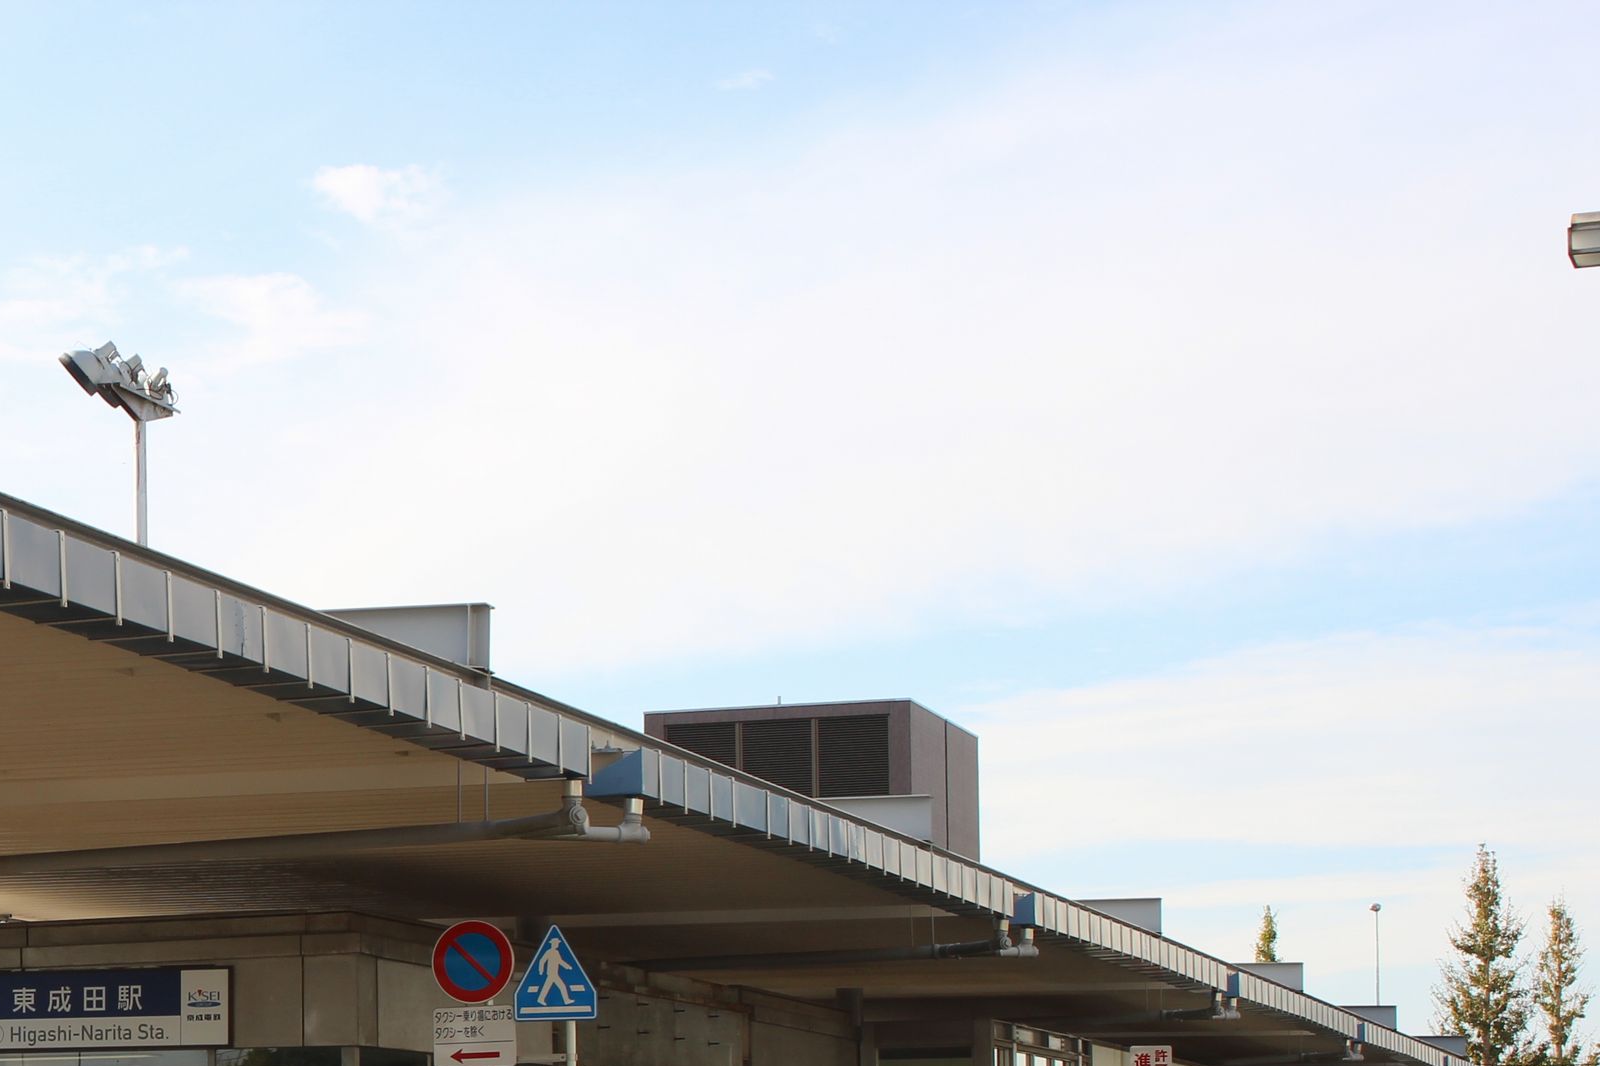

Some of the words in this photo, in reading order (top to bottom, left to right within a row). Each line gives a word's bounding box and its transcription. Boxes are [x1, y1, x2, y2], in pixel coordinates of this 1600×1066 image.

[12, 985, 143, 1013] 東成田駅
[10, 1025, 132, 1046] Higashi-Narita
[138, 1024, 169, 1040] Sta.
[435, 1025, 484, 1039] タクシーを除く
